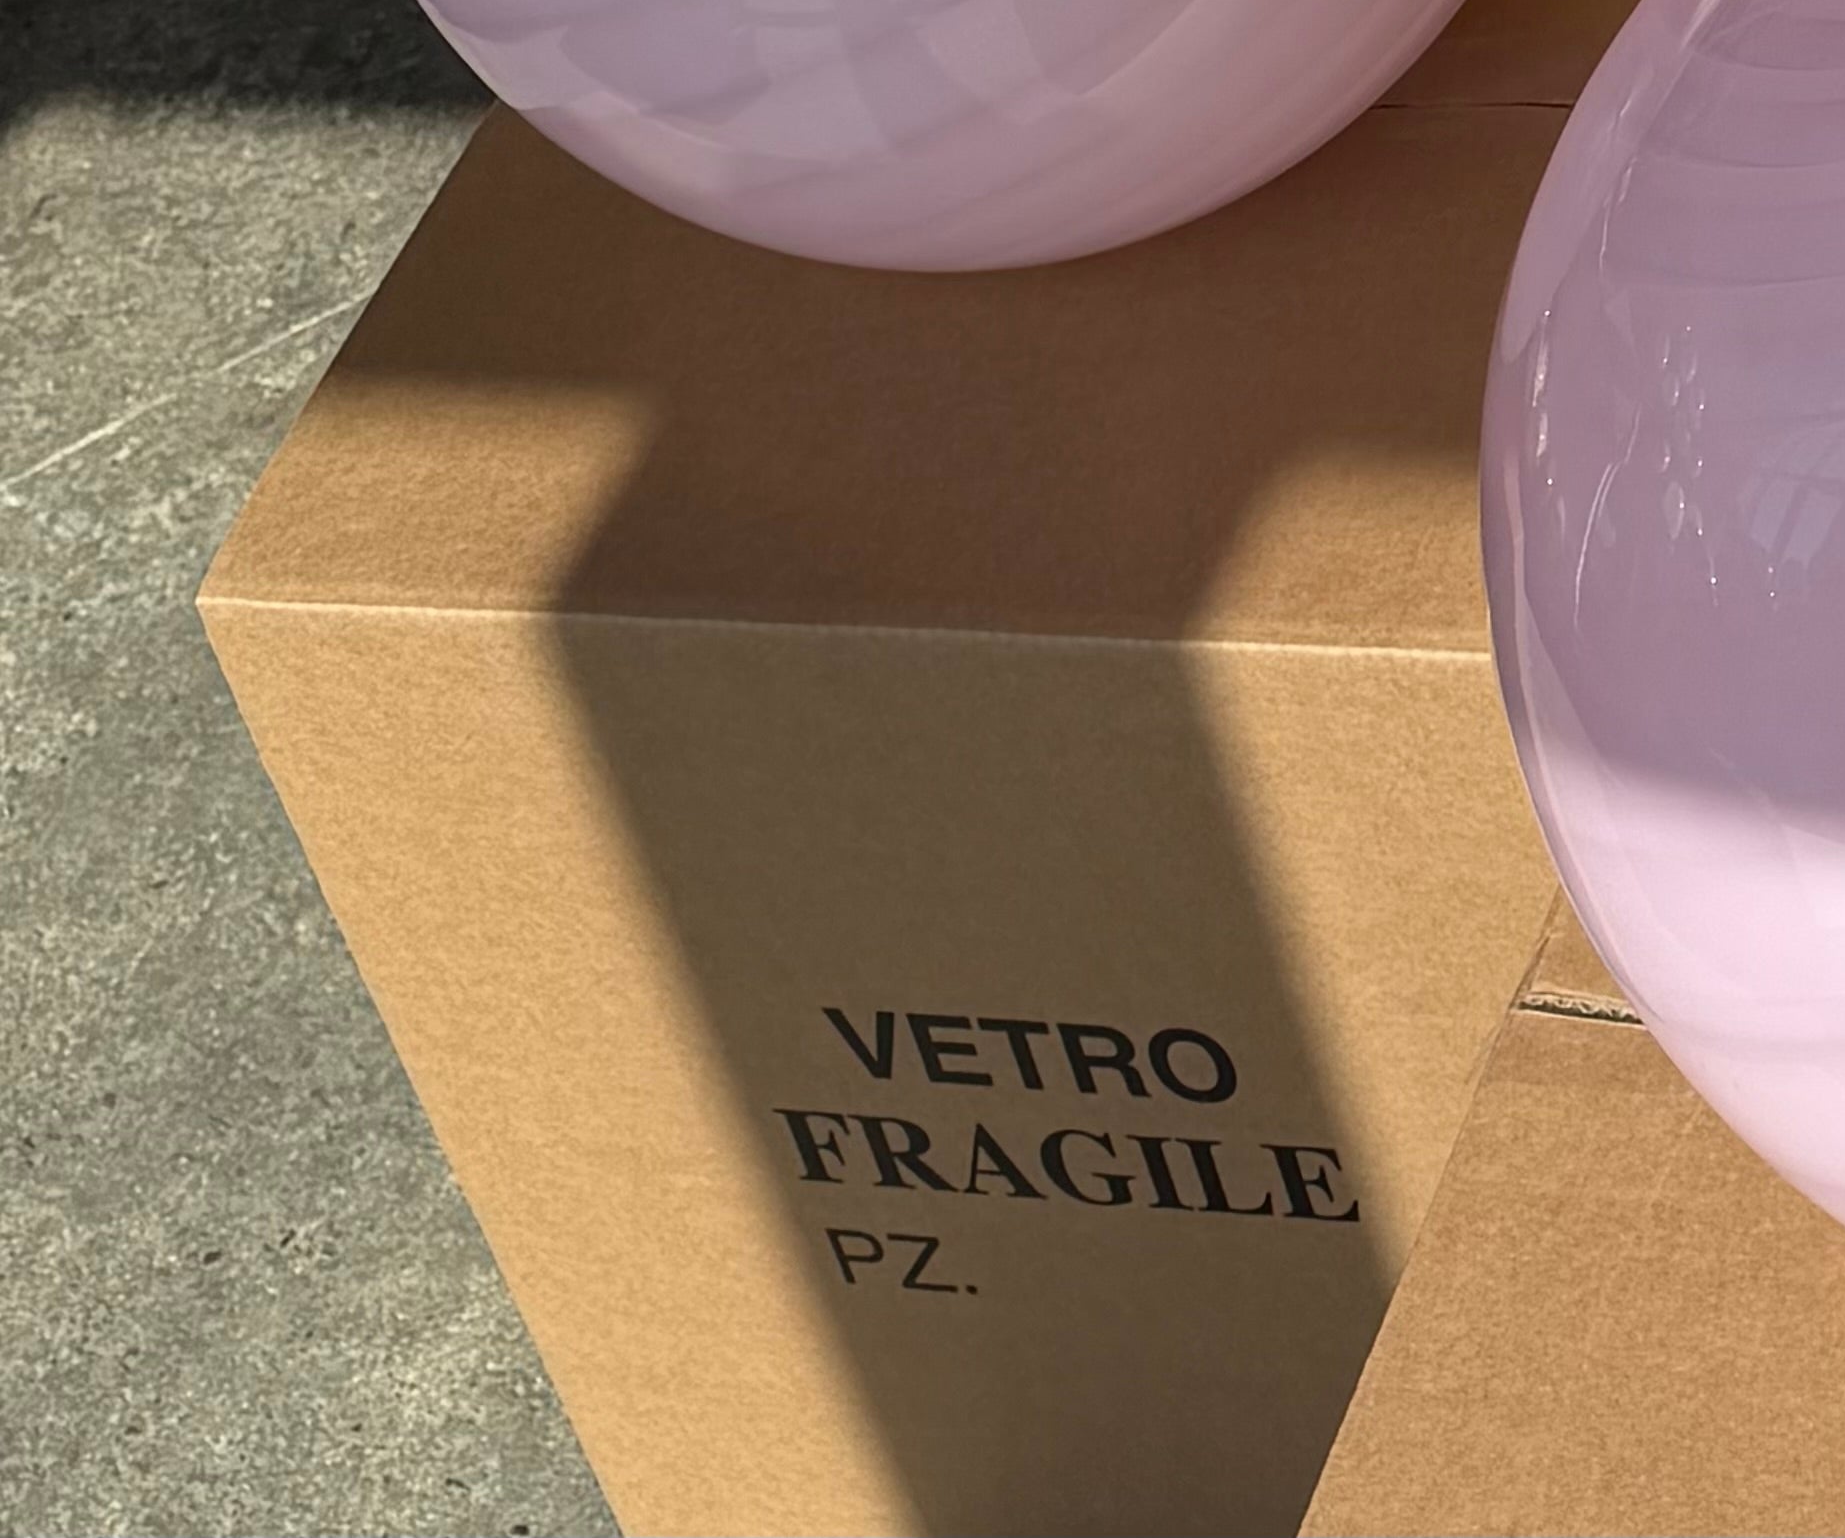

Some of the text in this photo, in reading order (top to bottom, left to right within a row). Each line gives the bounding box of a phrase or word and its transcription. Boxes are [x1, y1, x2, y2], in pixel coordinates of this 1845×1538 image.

[822, 1007, 1238, 1103] VETRO
[773, 1109, 1361, 1222] FRAGILE
[825, 1229, 979, 1296] PZ.
